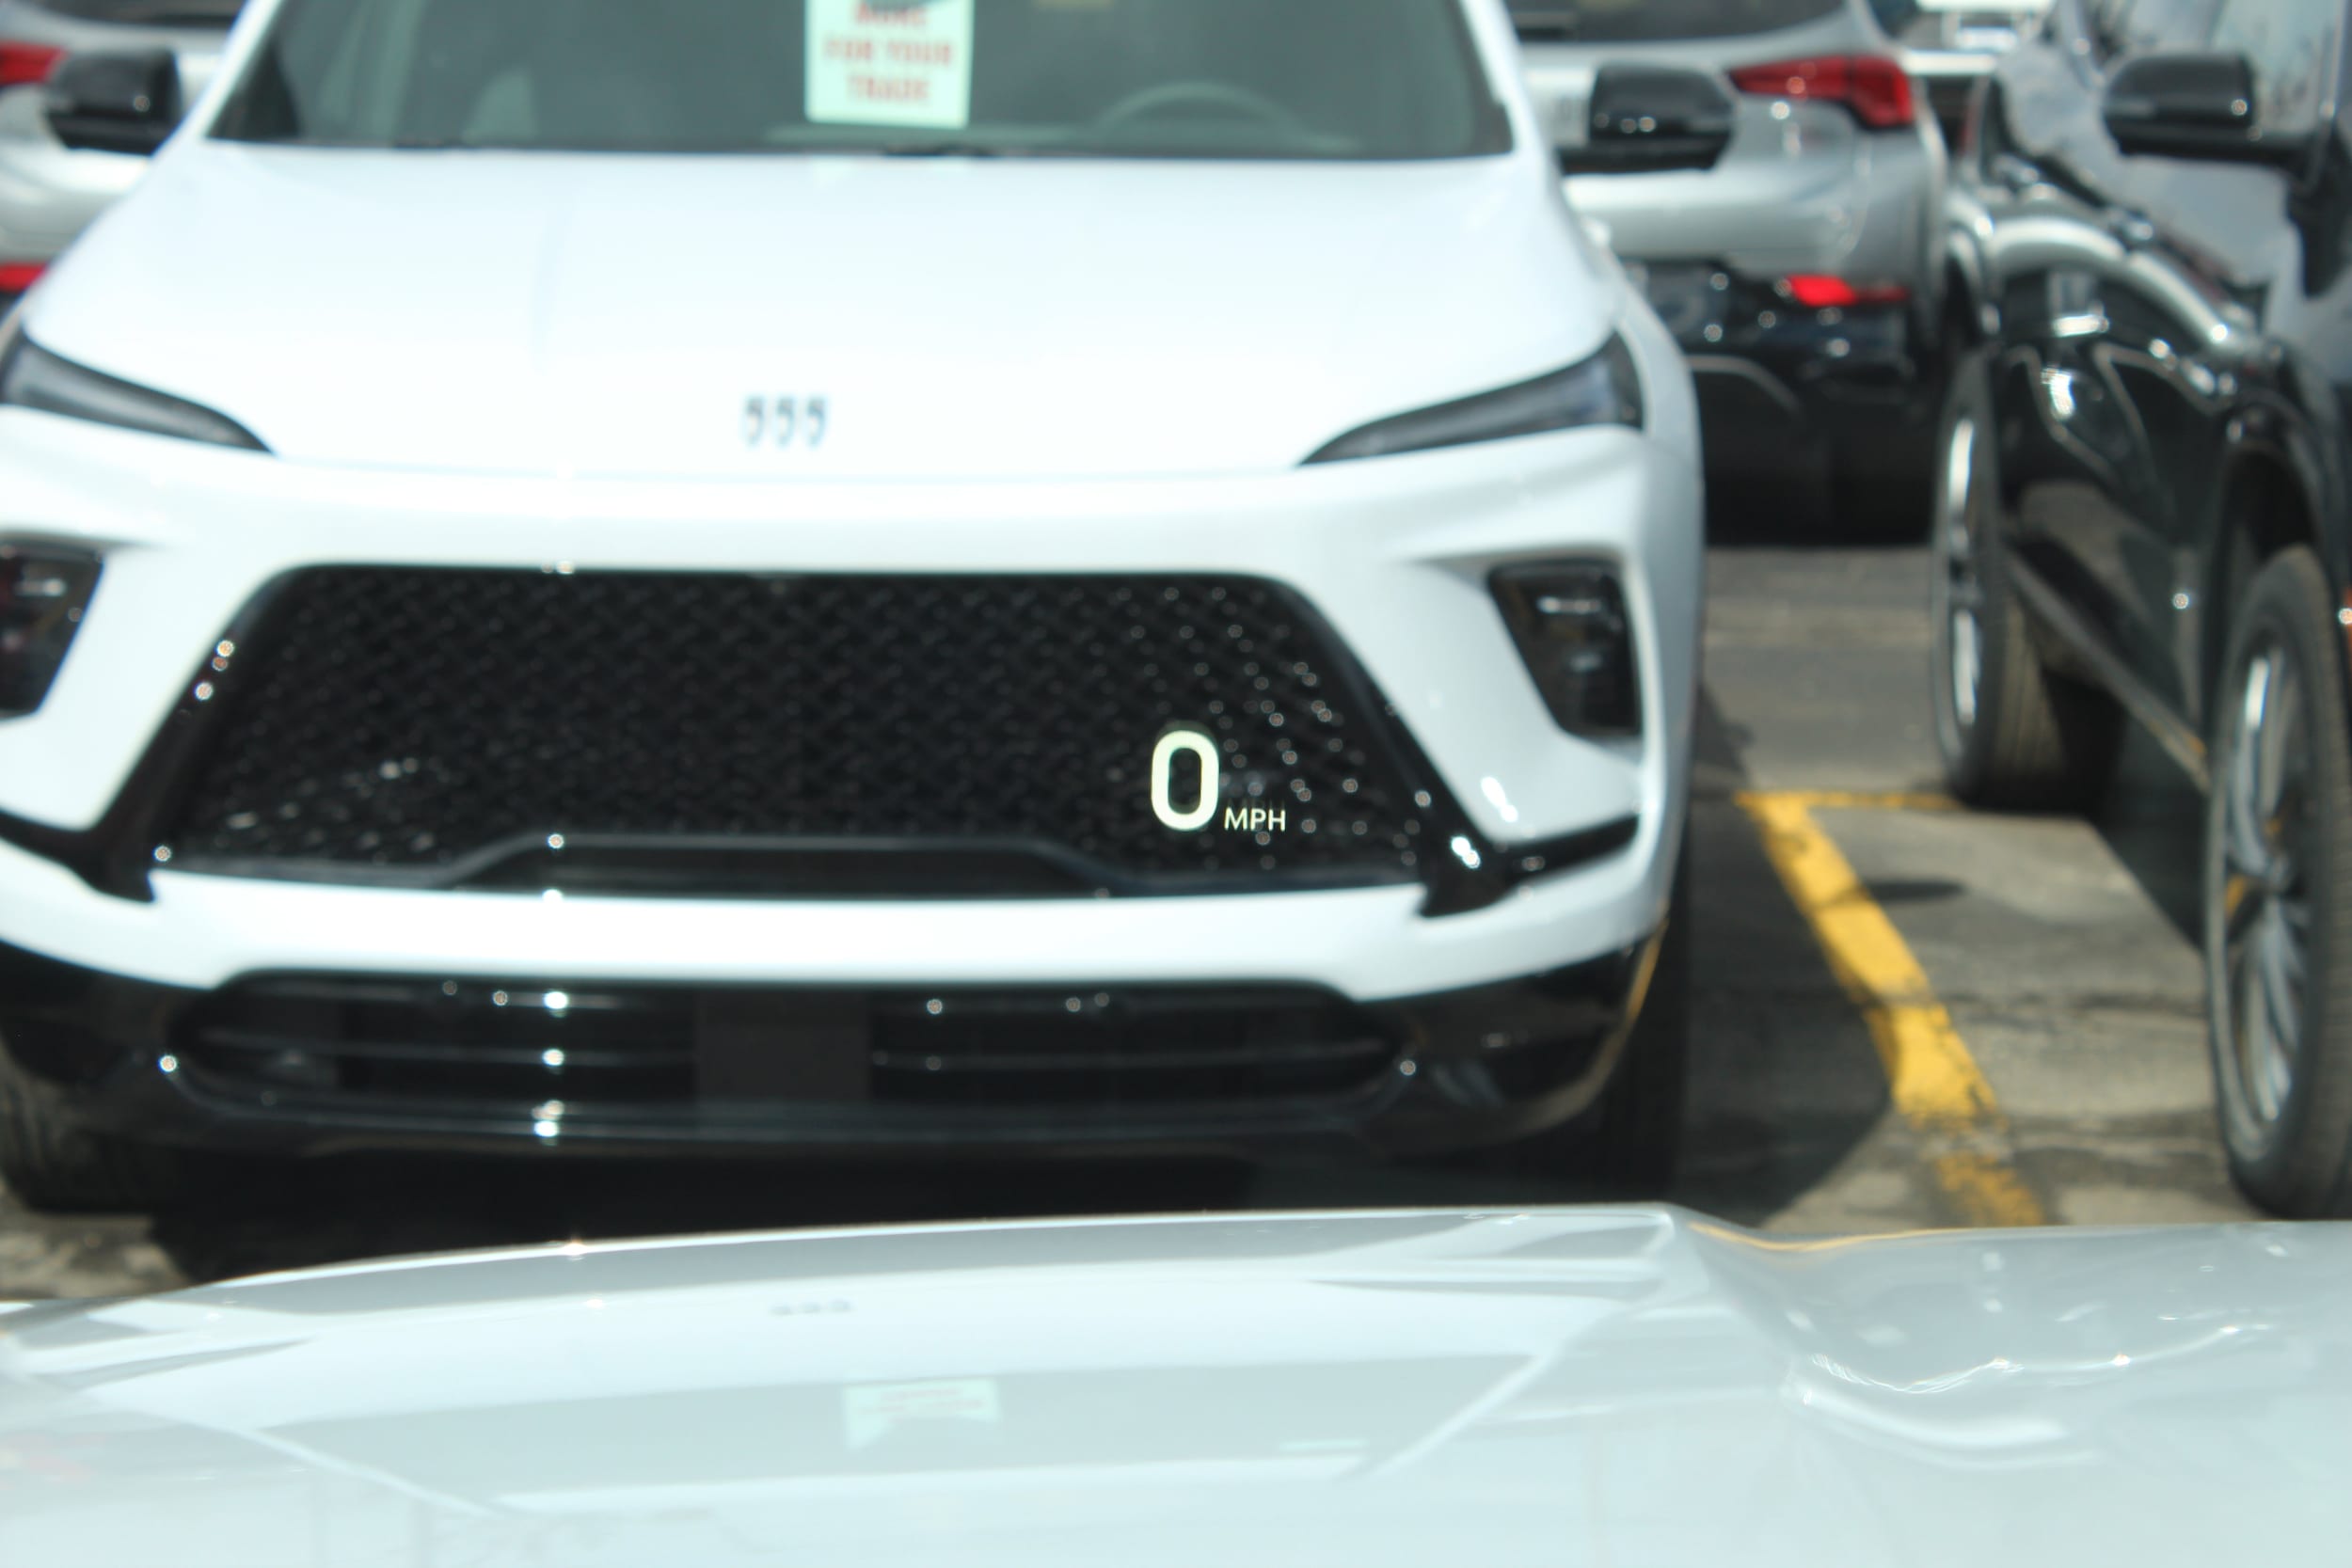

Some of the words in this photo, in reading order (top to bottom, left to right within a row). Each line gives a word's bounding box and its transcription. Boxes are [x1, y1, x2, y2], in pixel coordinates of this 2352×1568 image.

[824, 39, 873, 62] FOR
[886, 40, 952, 66] YOUR
[849, 75, 930, 102] TRADE
[1151, 728, 1219, 832] 0
[1224, 806, 1287, 832] MPH
